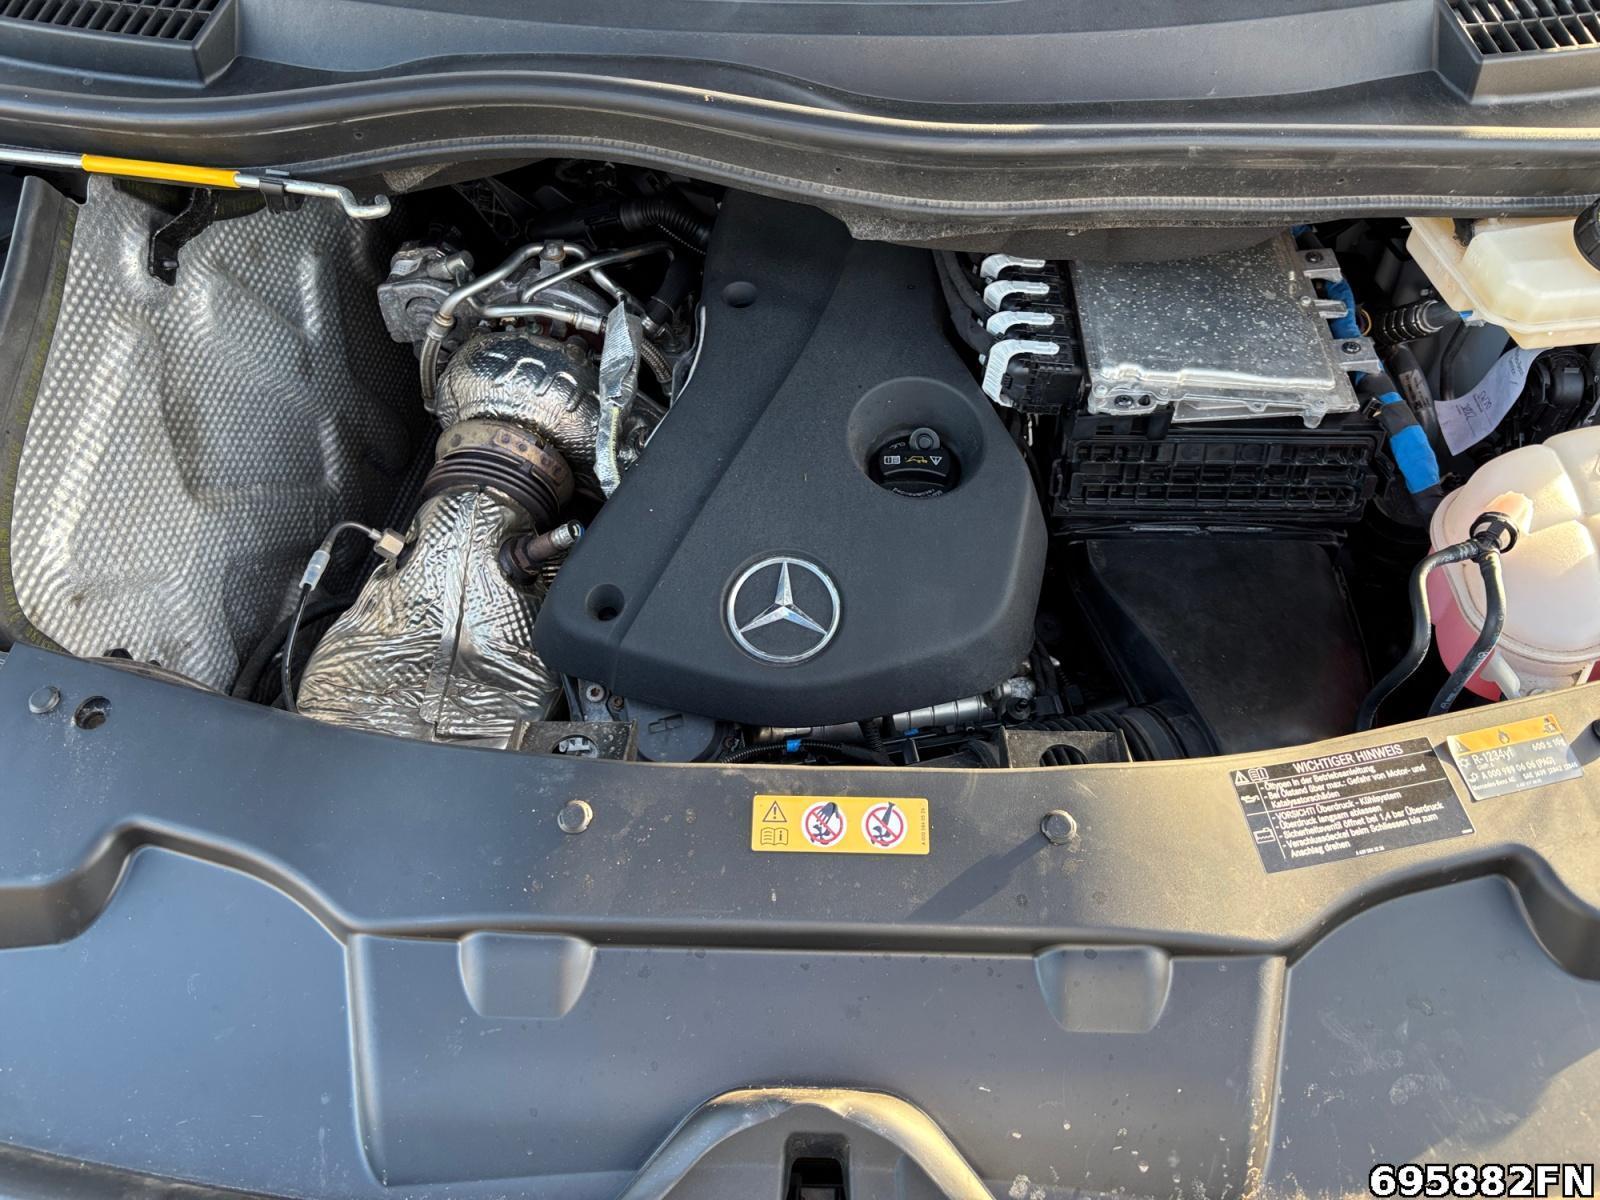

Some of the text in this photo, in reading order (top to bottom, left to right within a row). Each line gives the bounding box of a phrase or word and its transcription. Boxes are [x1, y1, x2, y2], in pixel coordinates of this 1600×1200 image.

[1292, 744, 1403, 773] WICHTIGER HINWEIS
[1472, 747, 1515, 766] R-1234yf
[1264, 779, 1293, 793] Öltypen
[1300, 776, 1313, 784] der
[1314, 765, 1375, 782] Betriebsanleitung
[1267, 790, 1280, 799] Bei
[1280, 784, 1308, 796] Ölstand
[1308, 783, 1325, 791] über
[1346, 774, 1371, 784] Gefahr
[1386, 767, 1411, 777] Motor-
[1410, 763, 1426, 772] und
[1481, 771, 1488, 779] A
[1487, 768, 1501, 778] 000
[1515, 763, 1526, 771] 06
[1525, 760, 1536, 768] 06
[1272, 790, 1340, 809] Katalysatorschäden
[1316, 798, 1354, 812] Überdruck
[1359, 791, 1402, 806] Kühlsystem
[1279, 804, 1382, 829] Überdruck langsam ablassen
[1283, 800, 1444, 839] Sicherheitsventil öffnet bei 1,4 bar Überdruck
[1286, 829, 1349, 848] Verschlussdeckel
[1350, 825, 1369, 835] beim
[1369, 818, 1409, 831] Schliessen
[1409, 815, 1421, 824] bis
[1290, 839, 1350, 859] Anschlag drehen
